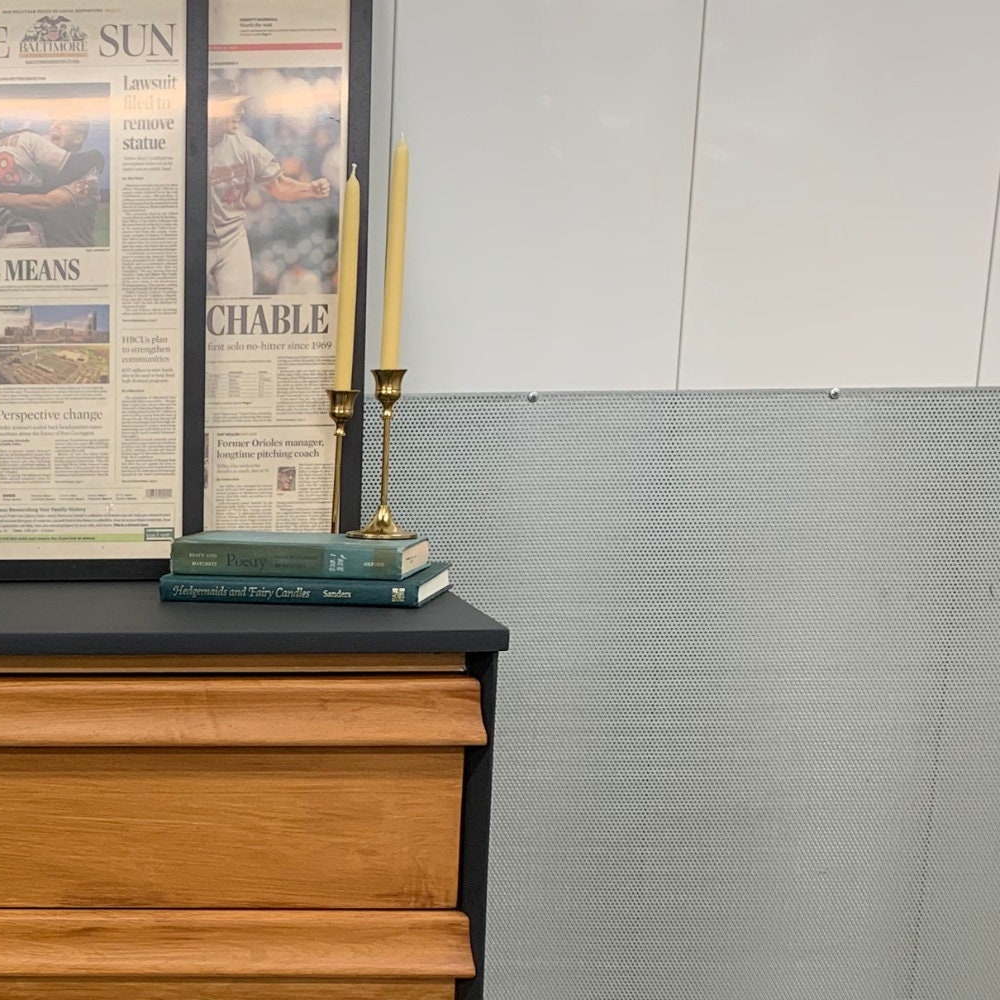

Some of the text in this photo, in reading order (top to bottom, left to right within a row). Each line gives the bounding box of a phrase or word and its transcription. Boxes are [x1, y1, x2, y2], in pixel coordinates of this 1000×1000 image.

[19, 41, 88, 53] BALTIMORE
[99, 23, 177, 57] SUN
[123, 74, 177, 91] Lawsuit
[123, 94, 171, 110] filed to
[123, 118, 175, 130] remove
[122, 136, 166, 150] statue
[5, 258, 80, 281] MEANS
[206, 304, 329, 336] CHABLE
[151, 335, 168, 345] plan
[207, 341, 333, 351] first solo no-hitter since 1969
[63, 408, 103, 421] change
[217, 438, 325, 449] Former Orioles manager,
[216, 449, 319, 460] longtime pitching coach
[226, 553, 266, 570] Poetry
[173, 585, 352, 600] Hedgemaids and Fairy Candles Sanders
